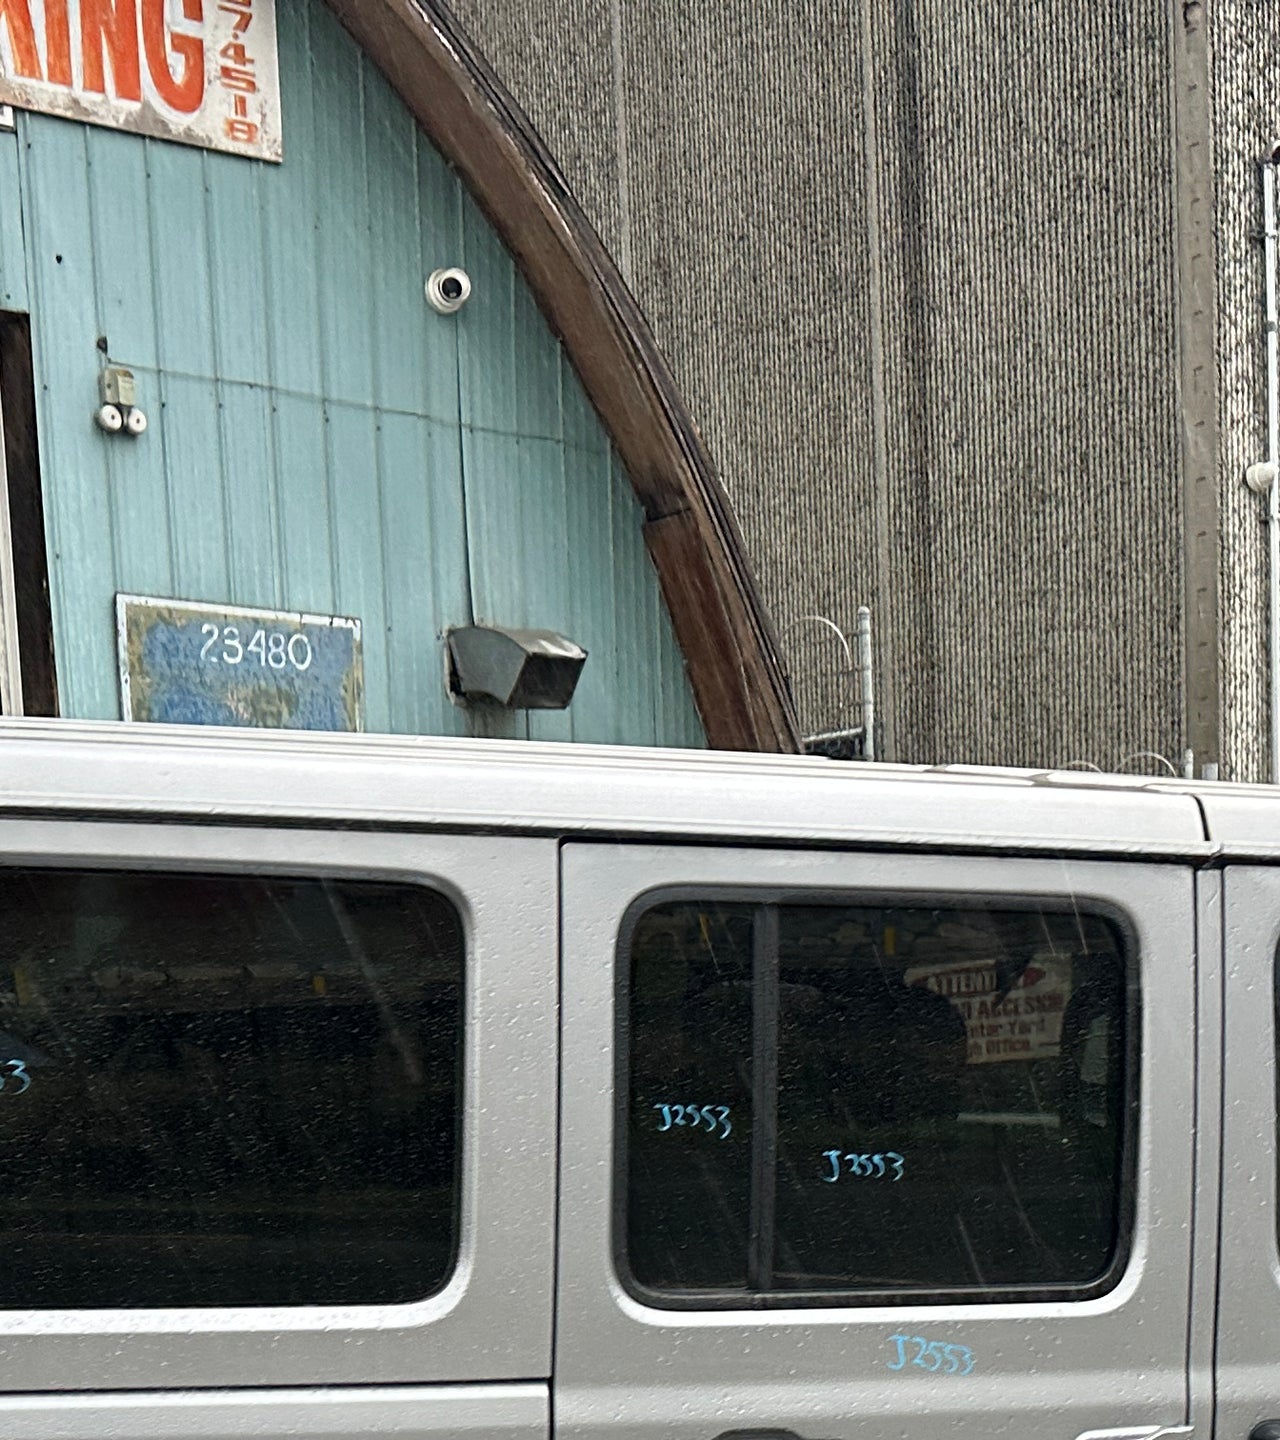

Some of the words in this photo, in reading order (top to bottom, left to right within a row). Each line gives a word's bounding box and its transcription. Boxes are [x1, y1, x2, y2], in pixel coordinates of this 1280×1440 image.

[201, 623, 312, 671] 23480
[653, 1103, 731, 1140] J2553
[821, 1149, 905, 1183] J2553
[886, 1334, 976, 1377] J2553
